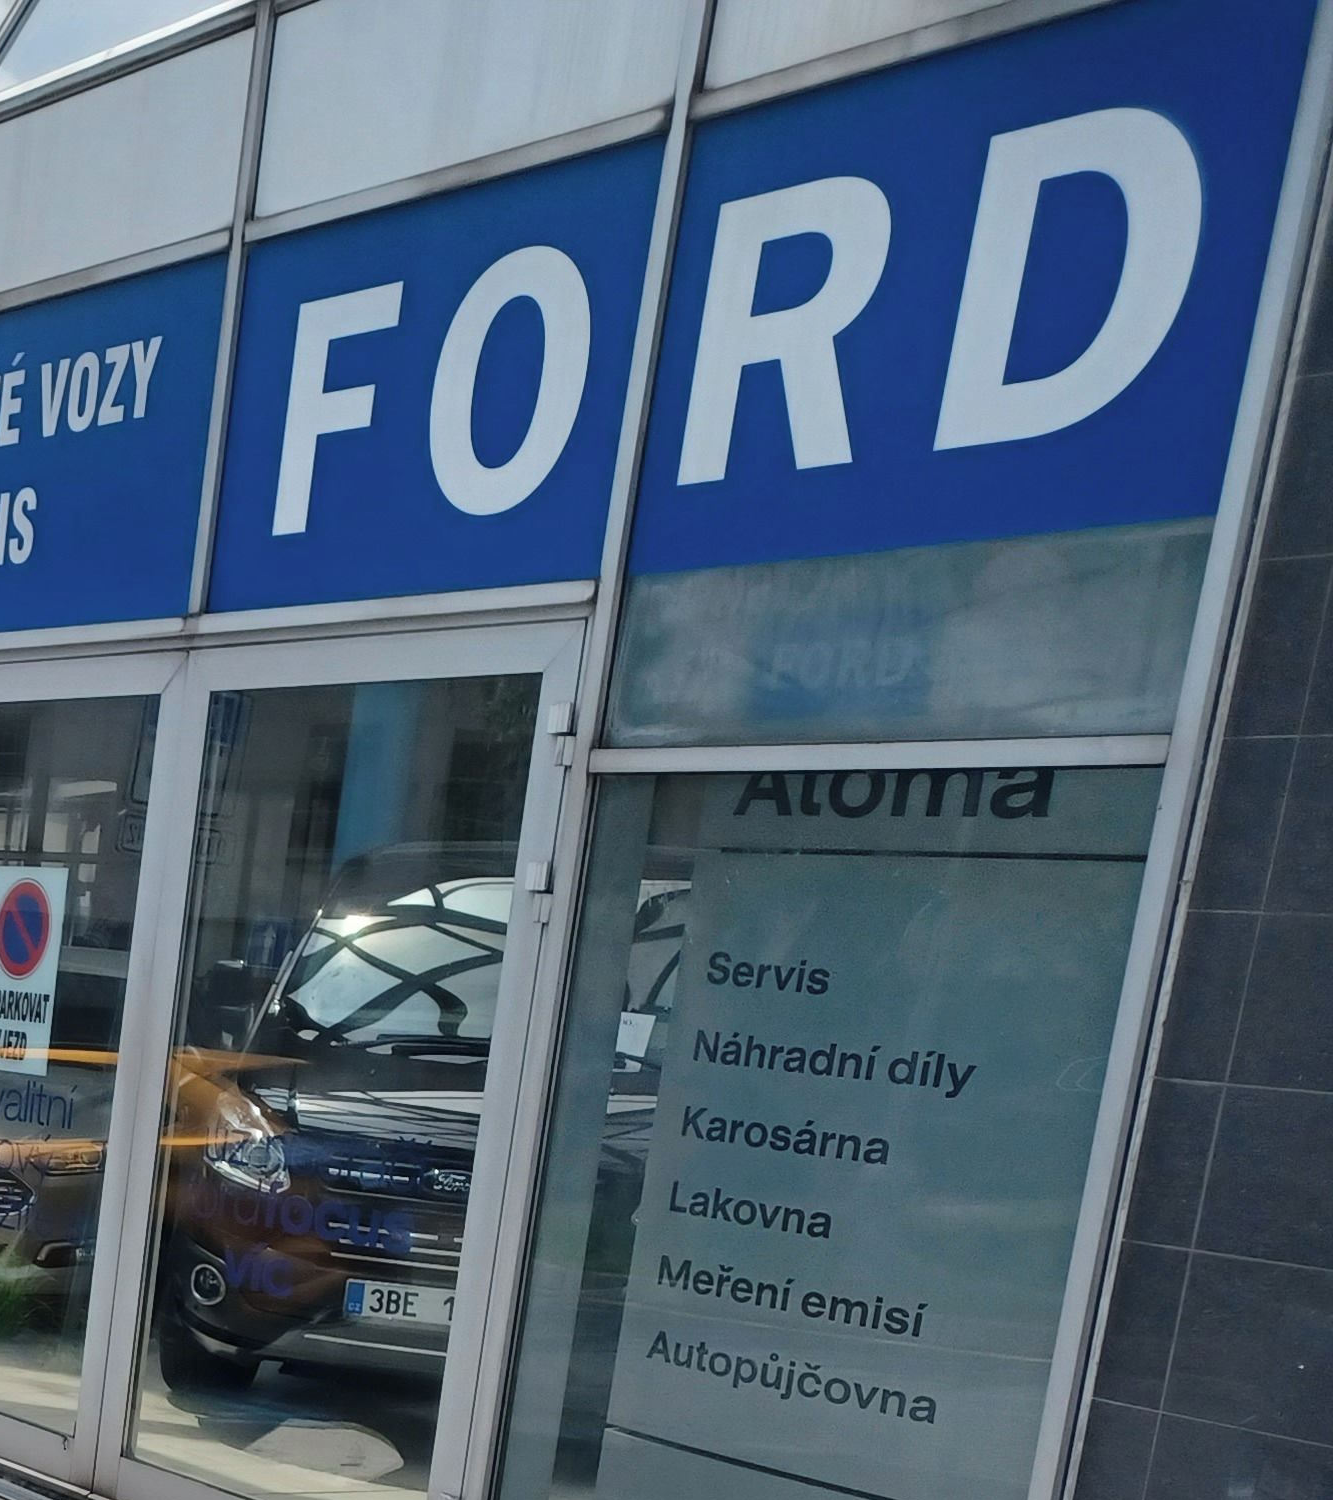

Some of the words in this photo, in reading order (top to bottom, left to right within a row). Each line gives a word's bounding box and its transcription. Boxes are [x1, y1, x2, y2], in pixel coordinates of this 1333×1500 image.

[272, 107, 1204, 537] FORD
[40, 335, 163, 438] VOZY
[706, 951, 831, 996] Servis
[692, 1028, 882, 1081] Náhradní
[887, 1050, 978, 1099] díly
[681, 1105, 890, 1165] Karosárna
[669, 1180, 832, 1239] Lakovna
[369, 1288, 420, 1318] 3BE
[656, 1254, 796, 1311] Meření
[800, 1290, 929, 1337] emisí
[645, 1330, 938, 1425] Autopůjčovna
